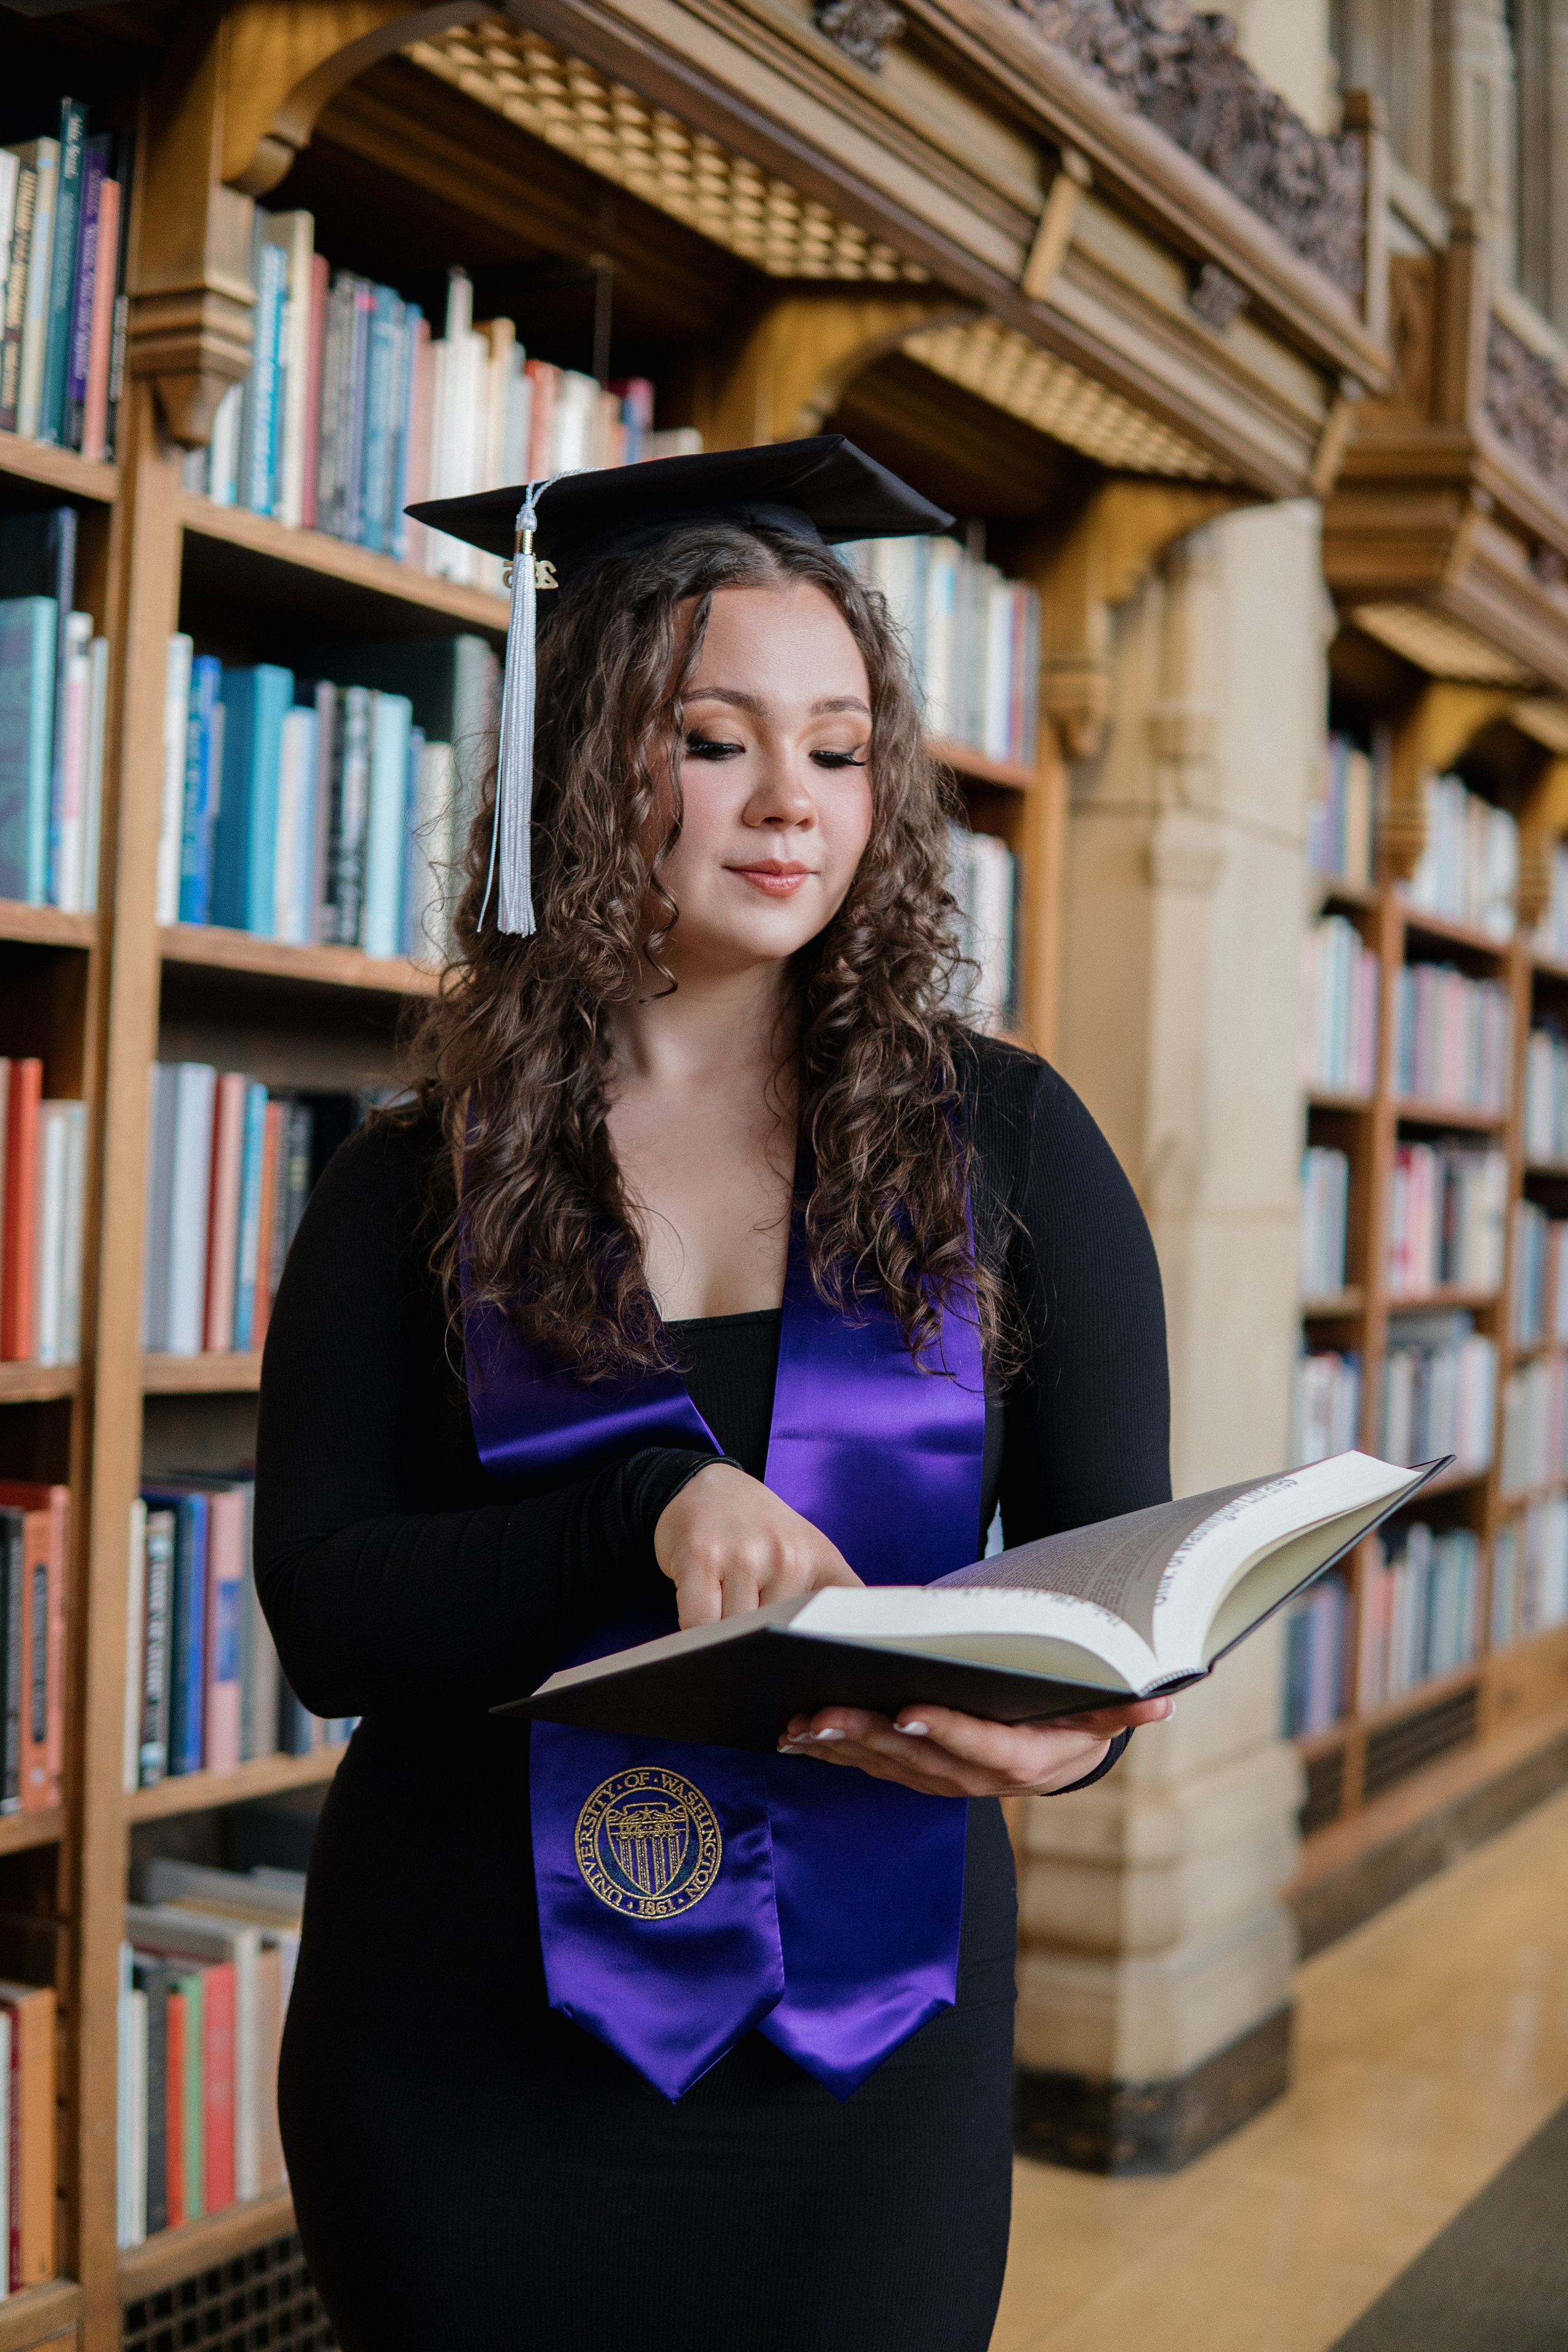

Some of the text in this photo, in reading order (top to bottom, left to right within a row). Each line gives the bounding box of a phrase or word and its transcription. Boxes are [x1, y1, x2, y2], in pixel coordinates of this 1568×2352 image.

[579, 1772, 717, 1907] UNIVERSITY OF WASHINGTON
[638, 1899, 676, 1915] 1861
